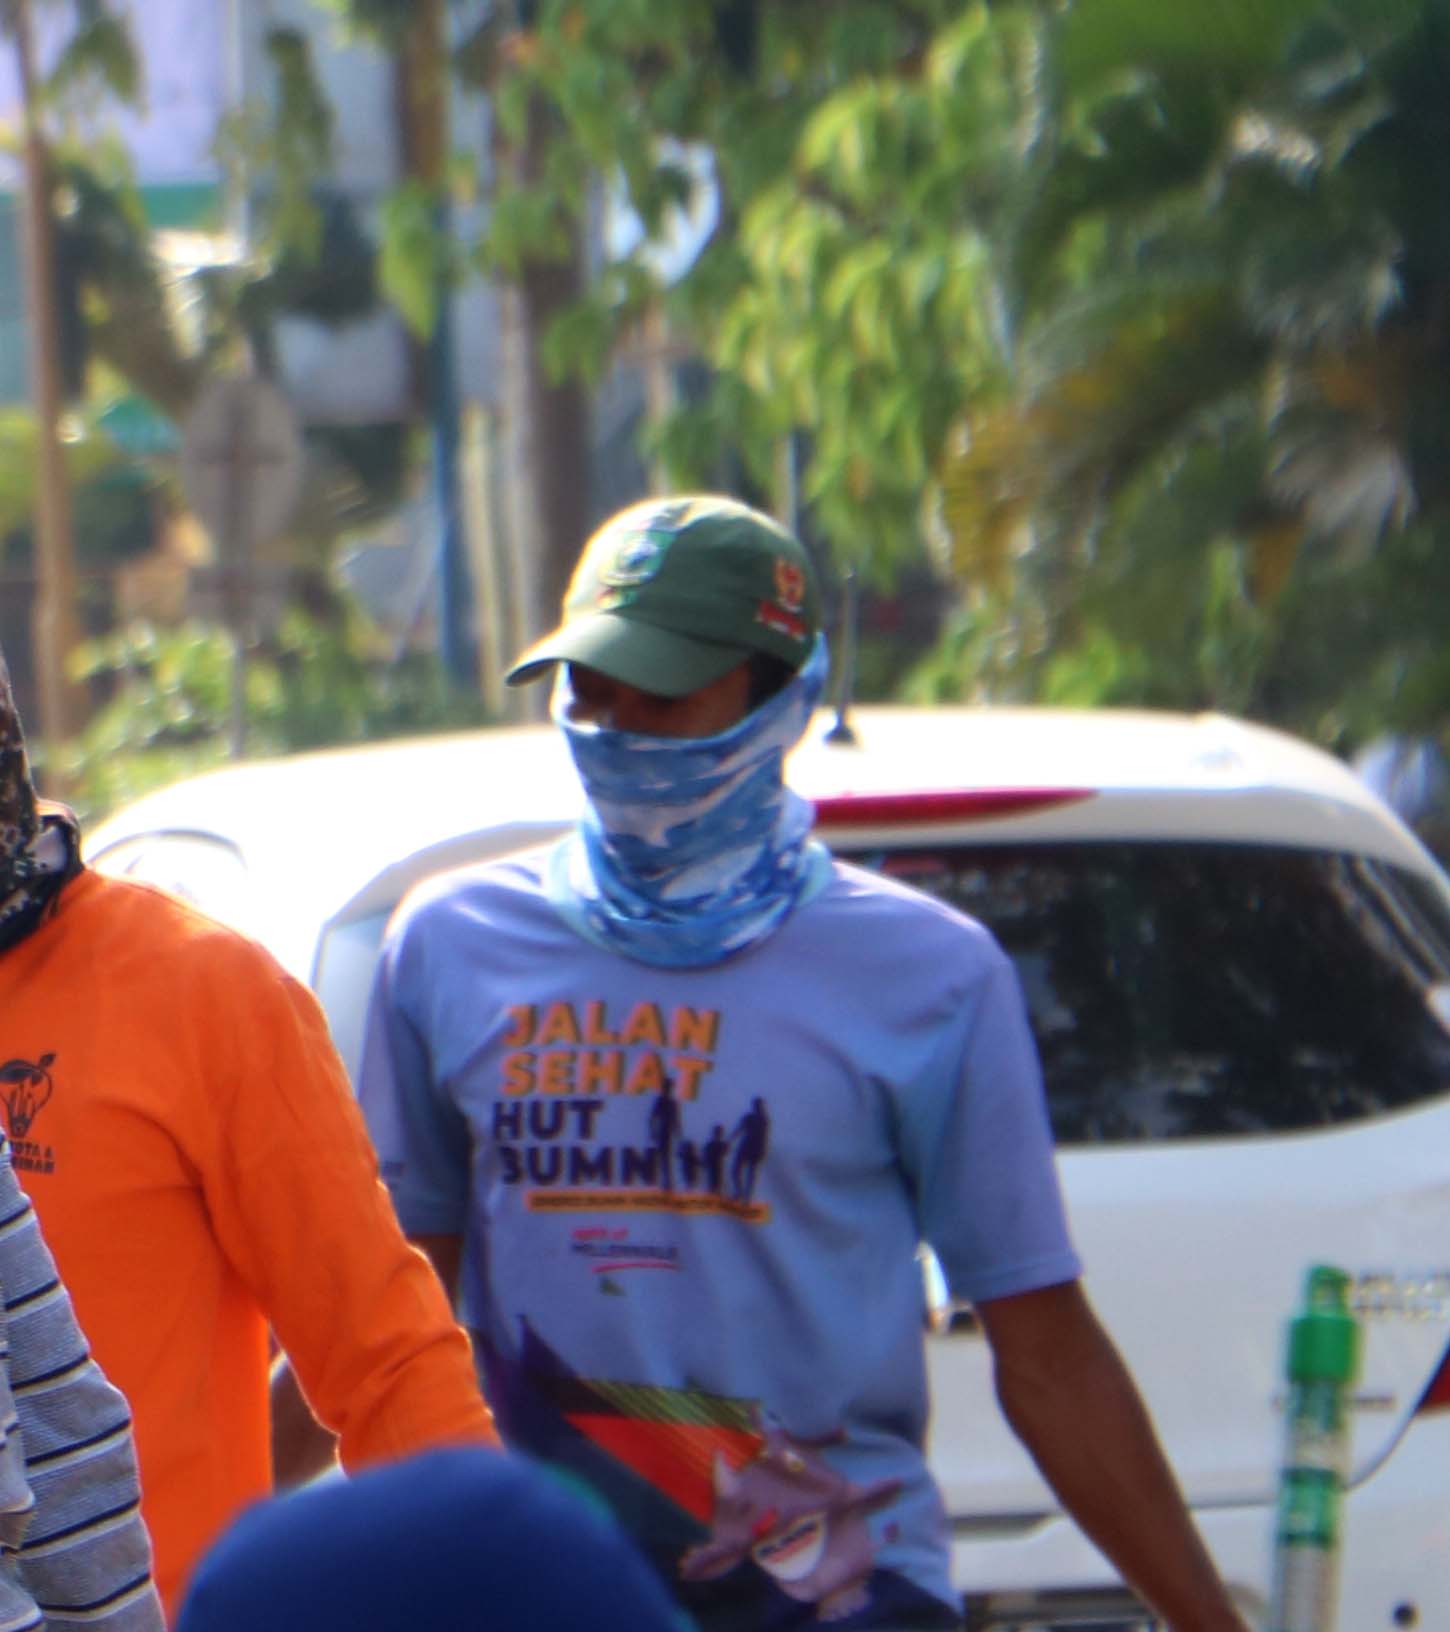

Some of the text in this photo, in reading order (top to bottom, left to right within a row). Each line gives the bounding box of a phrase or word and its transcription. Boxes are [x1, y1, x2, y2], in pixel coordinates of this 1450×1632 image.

[501, 999, 721, 1055] JALAN
[501, 1051, 714, 1101] SEHAT
[492, 1099, 605, 1141] HUT
[498, 1146, 660, 1186] BUMN
